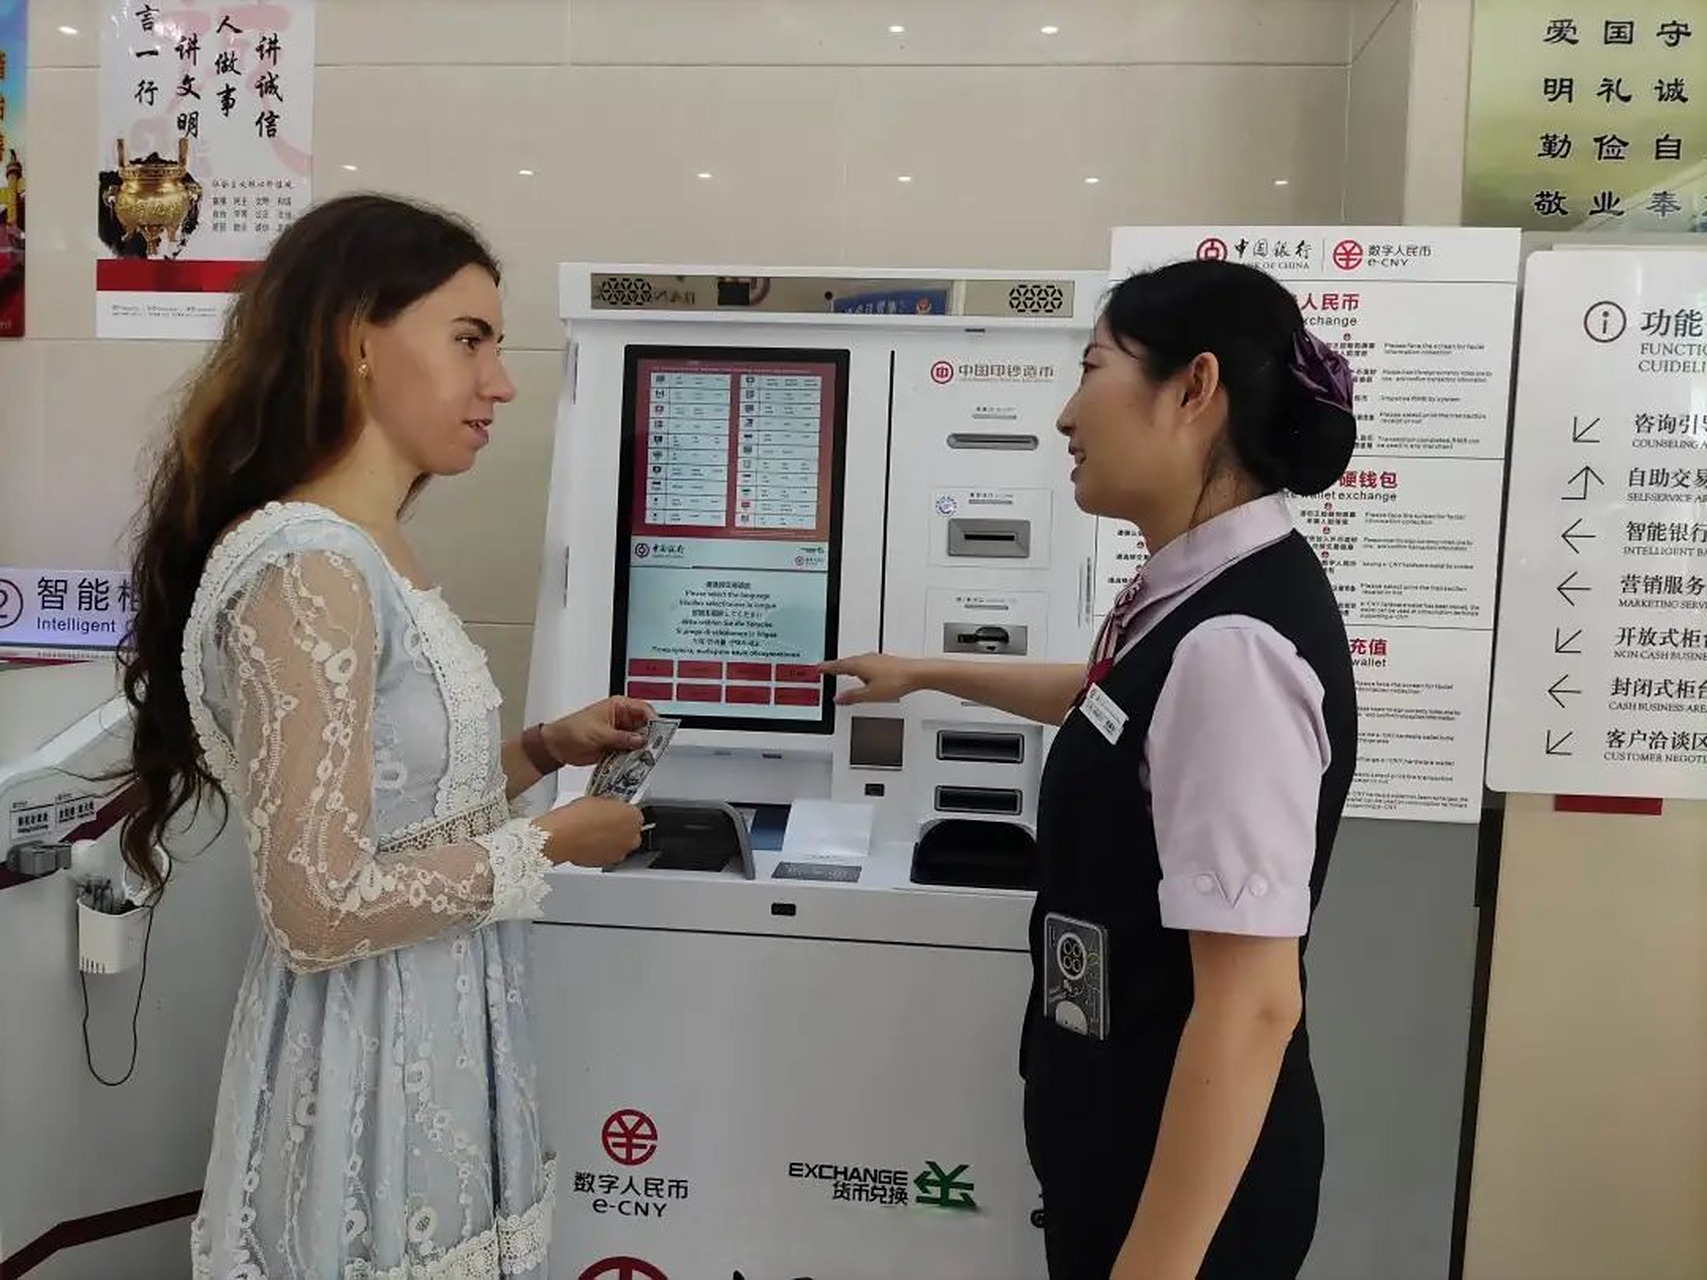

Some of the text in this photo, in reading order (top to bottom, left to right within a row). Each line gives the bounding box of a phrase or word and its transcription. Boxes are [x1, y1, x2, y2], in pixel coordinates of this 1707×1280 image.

[1544, 19, 1691, 47] 爱国守
[135, 5, 159, 106] 言一行
[215, 15, 243, 117] 人做事
[175, 33, 201, 138] 讲文明
[255, 33, 283, 138] 讲诚信
[1543, 78, 1689, 103] 明礼诚
[1538, 134, 1682, 160] 勤俭自
[1534, 191, 1707, 217] 敬业奉
[1234, 238, 1312, 259] 中国银行
[1367, 244, 1431, 257] 数字人民币
[1303, 316, 1358, 328] xchange
[1641, 309, 1703, 337] 功能
[1338, 490, 1397, 502] exchange
[1626, 521, 1707, 543] 智能银行
[1620, 574, 1706, 596] 营销服务
[37, 617, 116, 634] Intelligent
[1615, 627, 1707, 648] 开放式柜
[1350, 638, 1387, 655] 充值
[1351, 658, 1386, 668] wallet
[574, 1171, 688, 1200] 数字人民币
[788, 1162, 908, 1186] EXCHANGE
[832, 1180, 908, 1206] 货币兑换
[592, 1198, 667, 1217] e-CNY
